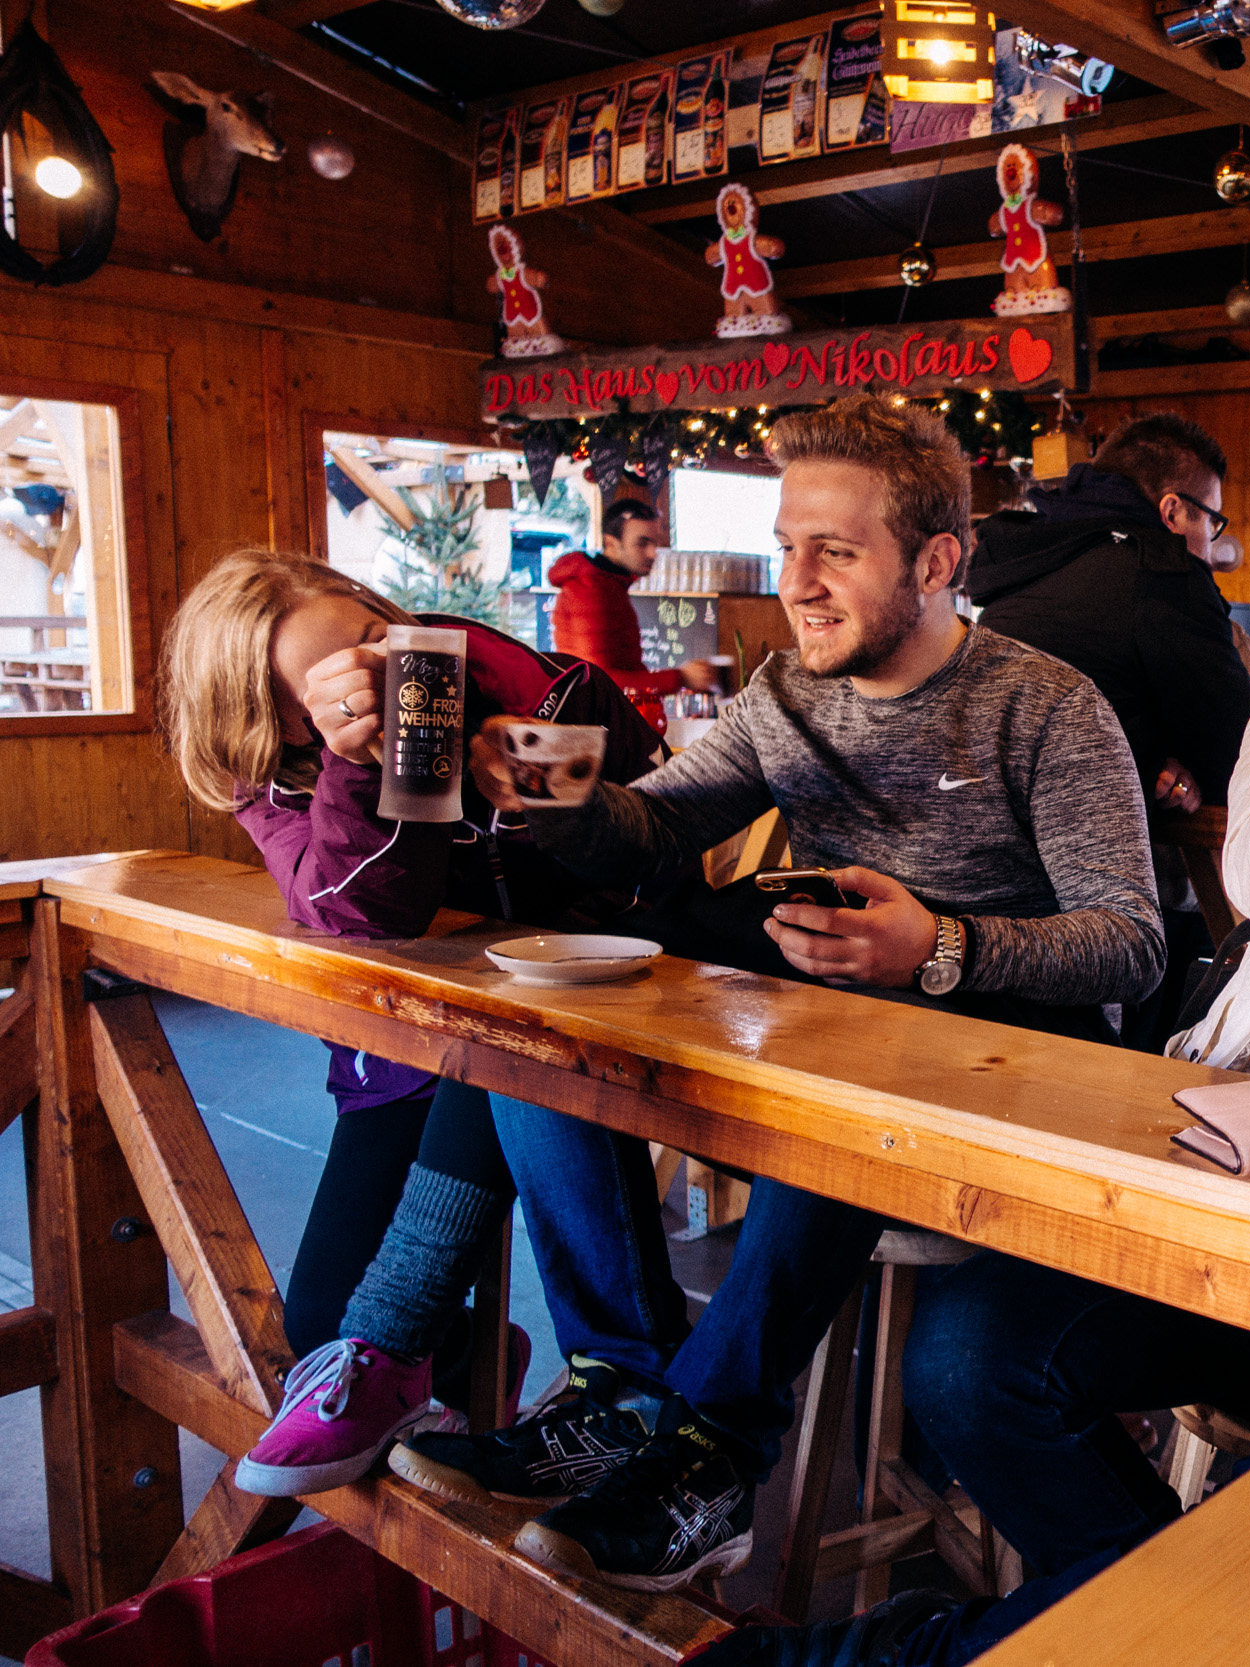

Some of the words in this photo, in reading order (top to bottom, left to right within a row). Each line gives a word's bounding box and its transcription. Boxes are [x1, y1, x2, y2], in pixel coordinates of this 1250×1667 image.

[484, 370, 553, 412] Das
[560, 364, 655, 411] Haus
[678, 354, 768, 396] vom
[784, 331, 1000, 389] Nikolaus
